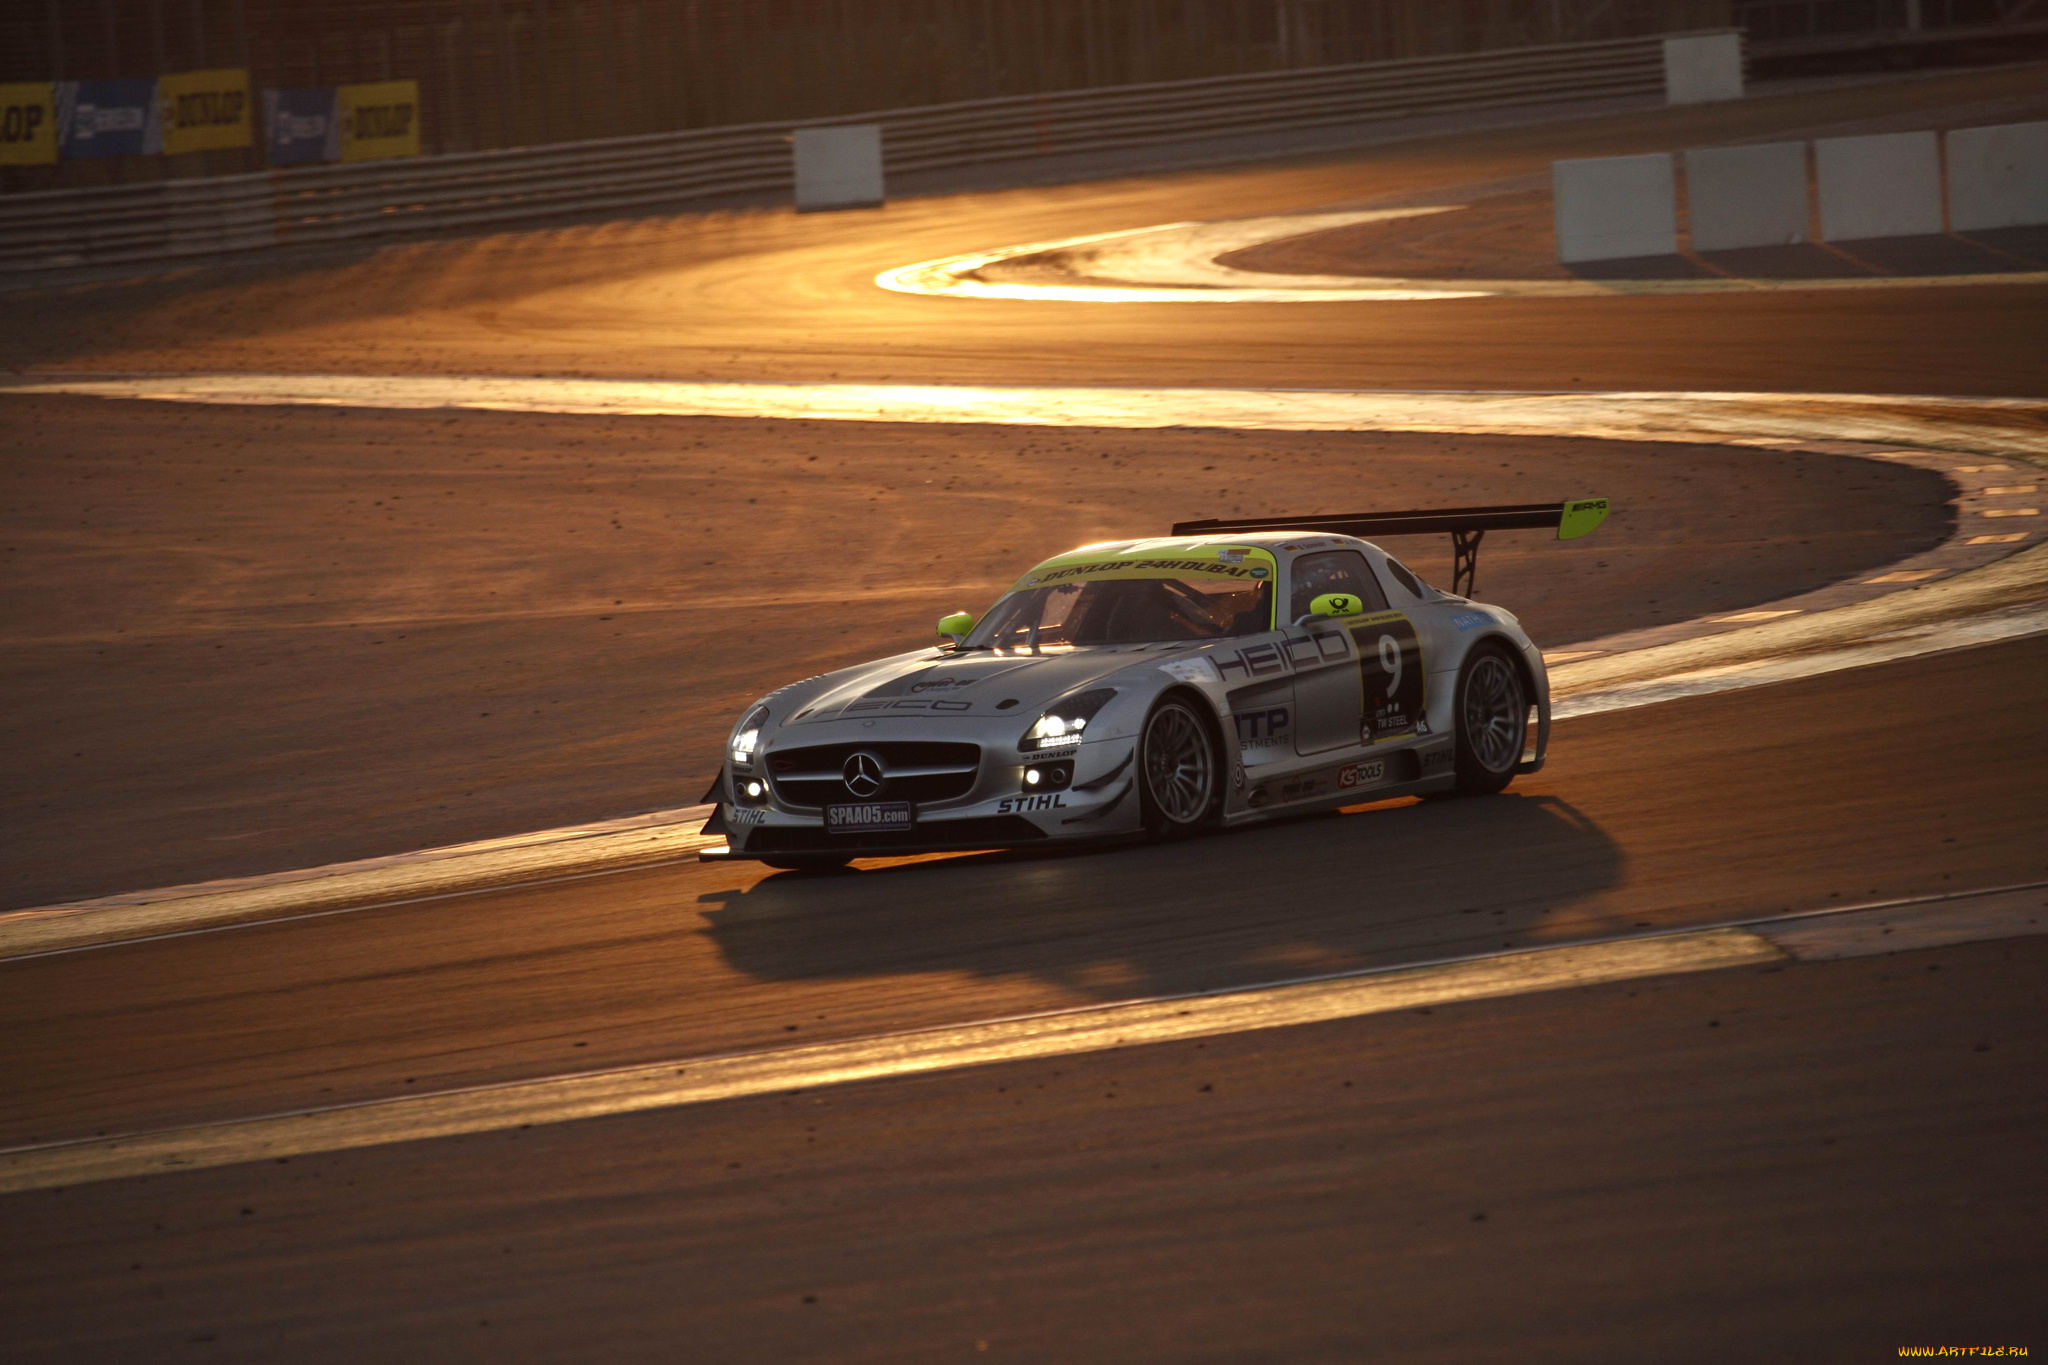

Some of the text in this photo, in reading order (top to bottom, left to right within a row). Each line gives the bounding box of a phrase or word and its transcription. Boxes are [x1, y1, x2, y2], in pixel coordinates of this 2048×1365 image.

[0, 105, 43, 142] OP
[1040, 561, 1134, 583] DUNLOP
[1208, 629, 1349, 682] HEICO
[1378, 634, 1402, 699] 9
[813, 700, 973, 719] HEICO
[1388, 714, 1408, 727] STEEL
[1416, 720, 1428, 733] A6
[1032, 749, 1077, 760] DUNLOP
[1357, 763, 1382, 780] TOOLS
[998, 794, 1067, 813] STIHL
[734, 809, 765, 824] STIHL
